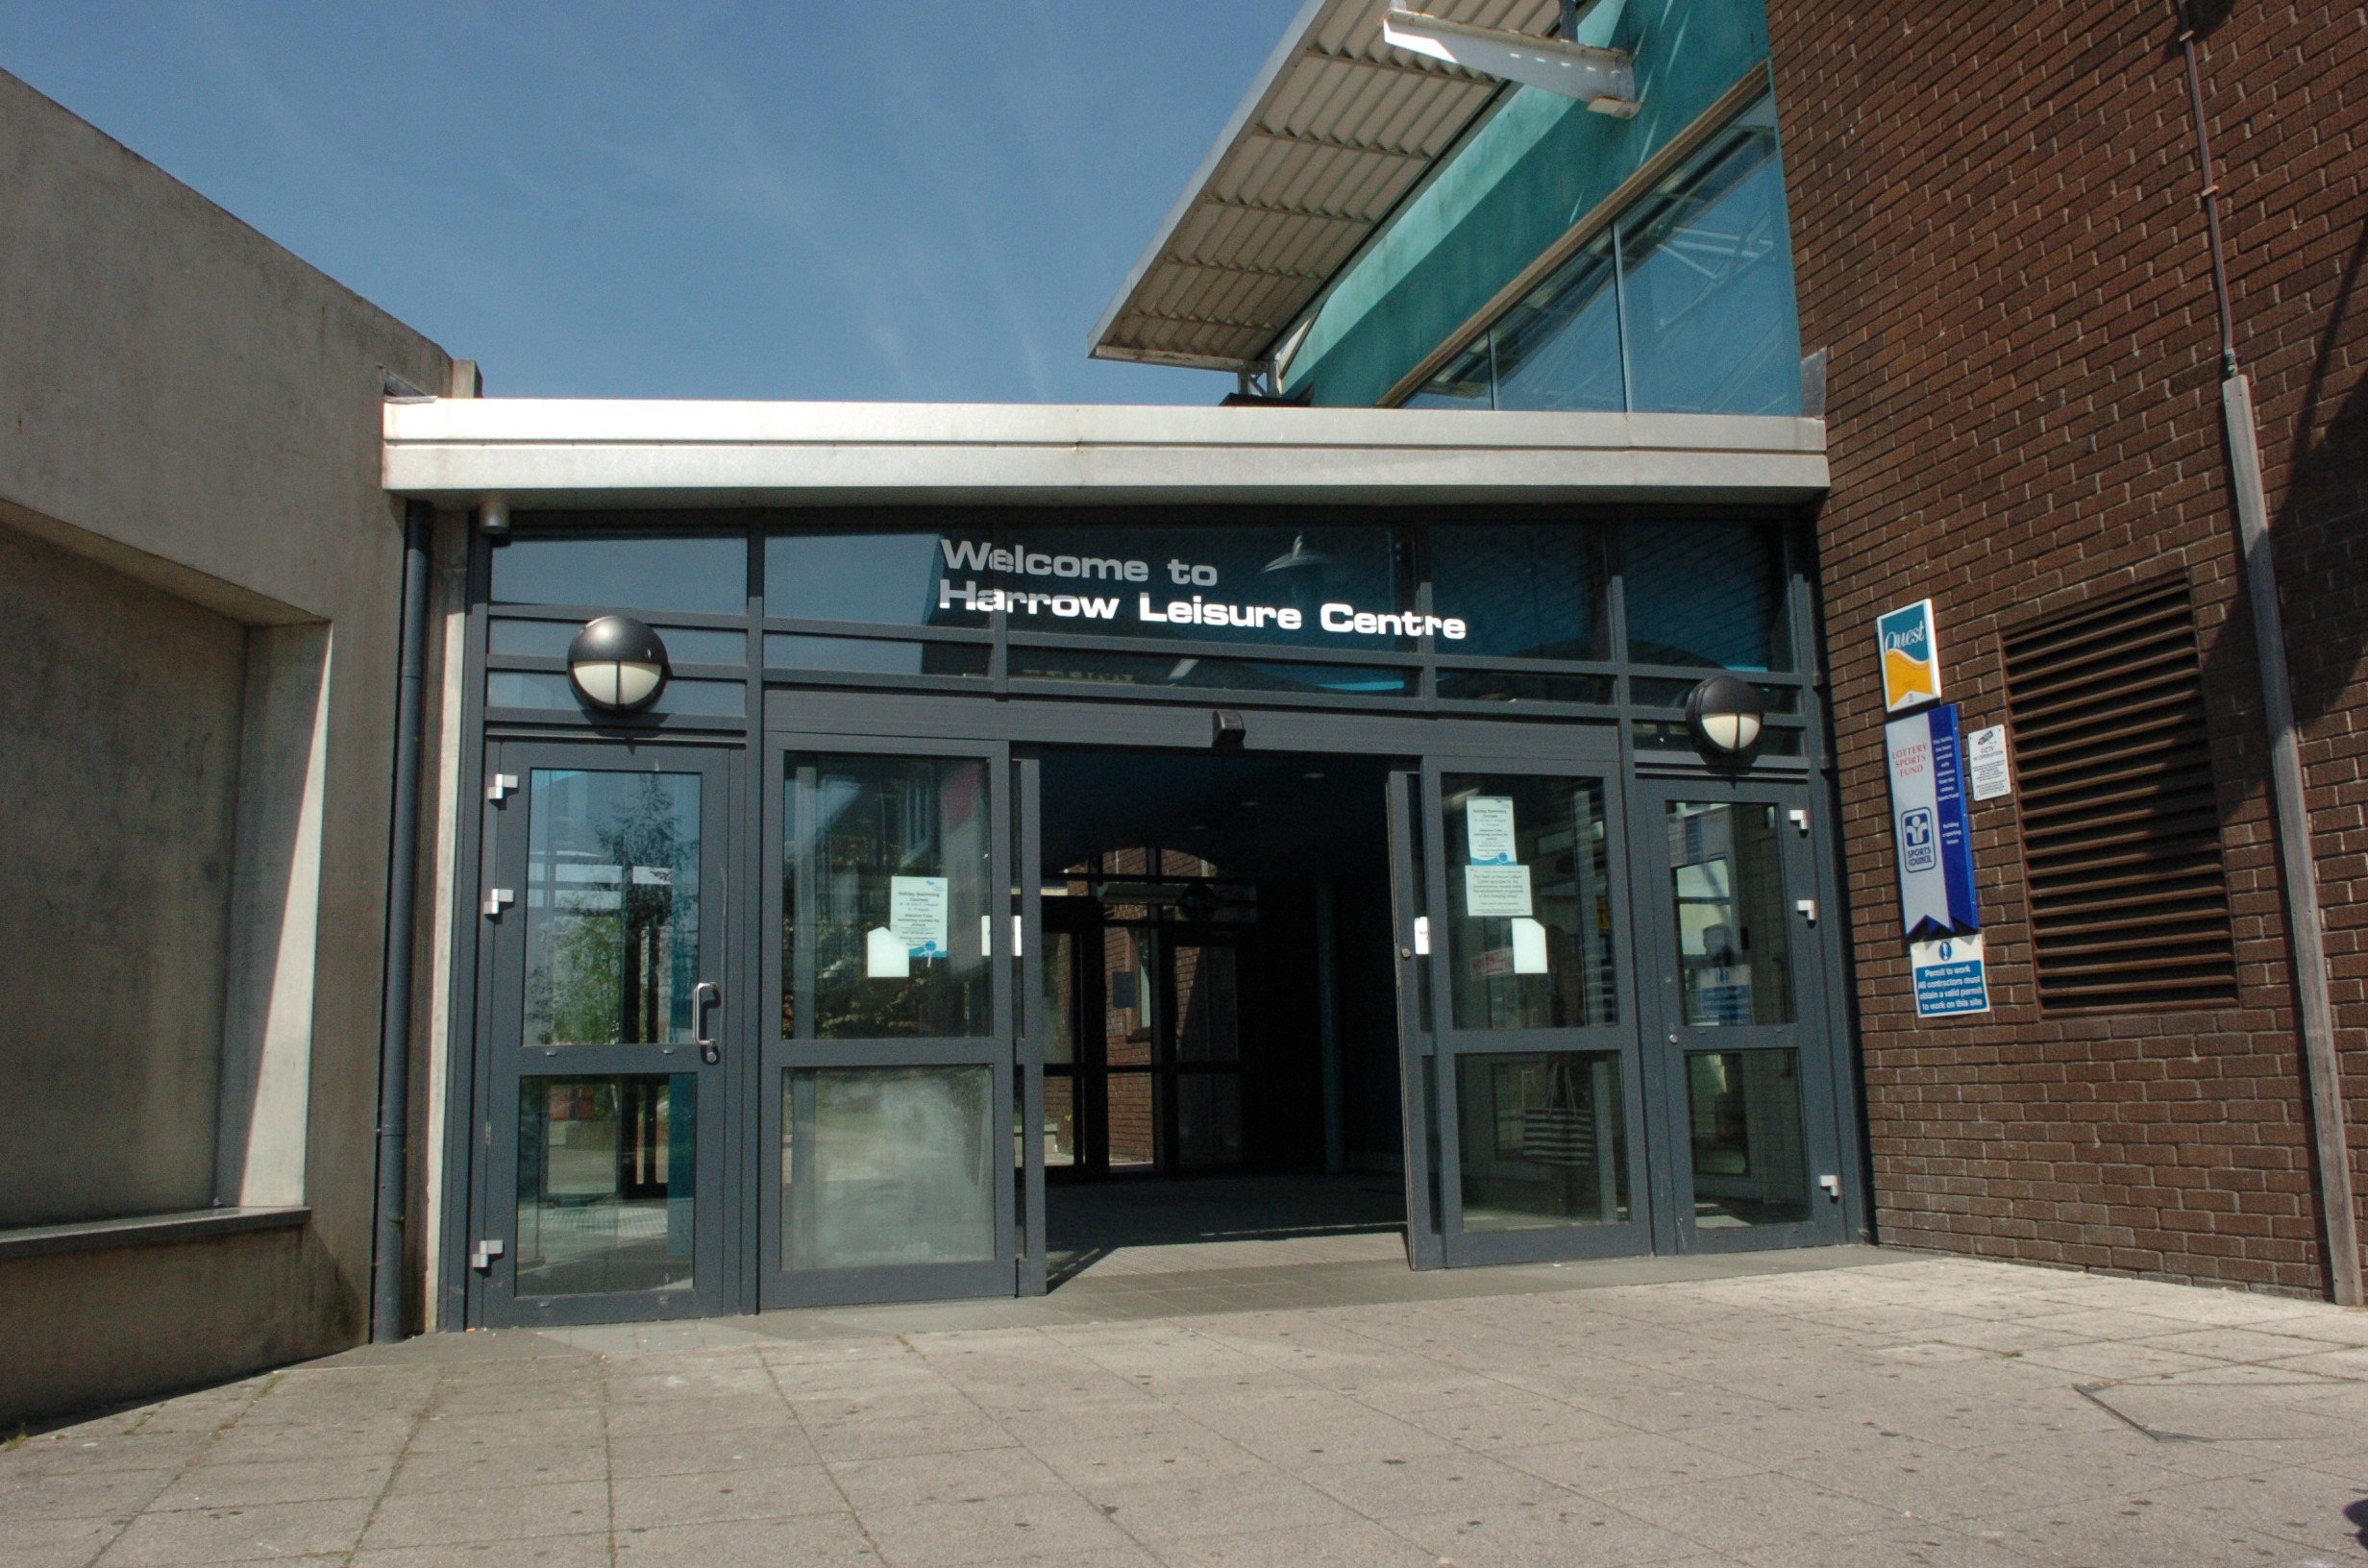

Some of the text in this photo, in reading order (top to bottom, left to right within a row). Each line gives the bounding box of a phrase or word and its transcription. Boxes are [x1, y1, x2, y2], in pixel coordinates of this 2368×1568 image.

[941, 539, 1218, 587] Welcome to
[939, 579, 1466, 639] Harrow Leisure Centre
[1885, 620, 1925, 651] Quest
[1891, 745, 1927, 759] LOTTERY
[1895, 754, 1926, 768] SPORTS
[1900, 765, 1923, 776] FUND
[1908, 846, 1932, 858] SPORTS
[1925, 968, 1946, 978] Permit
[1954, 965, 1971, 974] work
[1927, 978, 1963, 988] contractors
[1944, 989, 1960, 997] valid
[1961, 987, 1984, 997] permit
[1930, 1001, 1945, 1010] work
